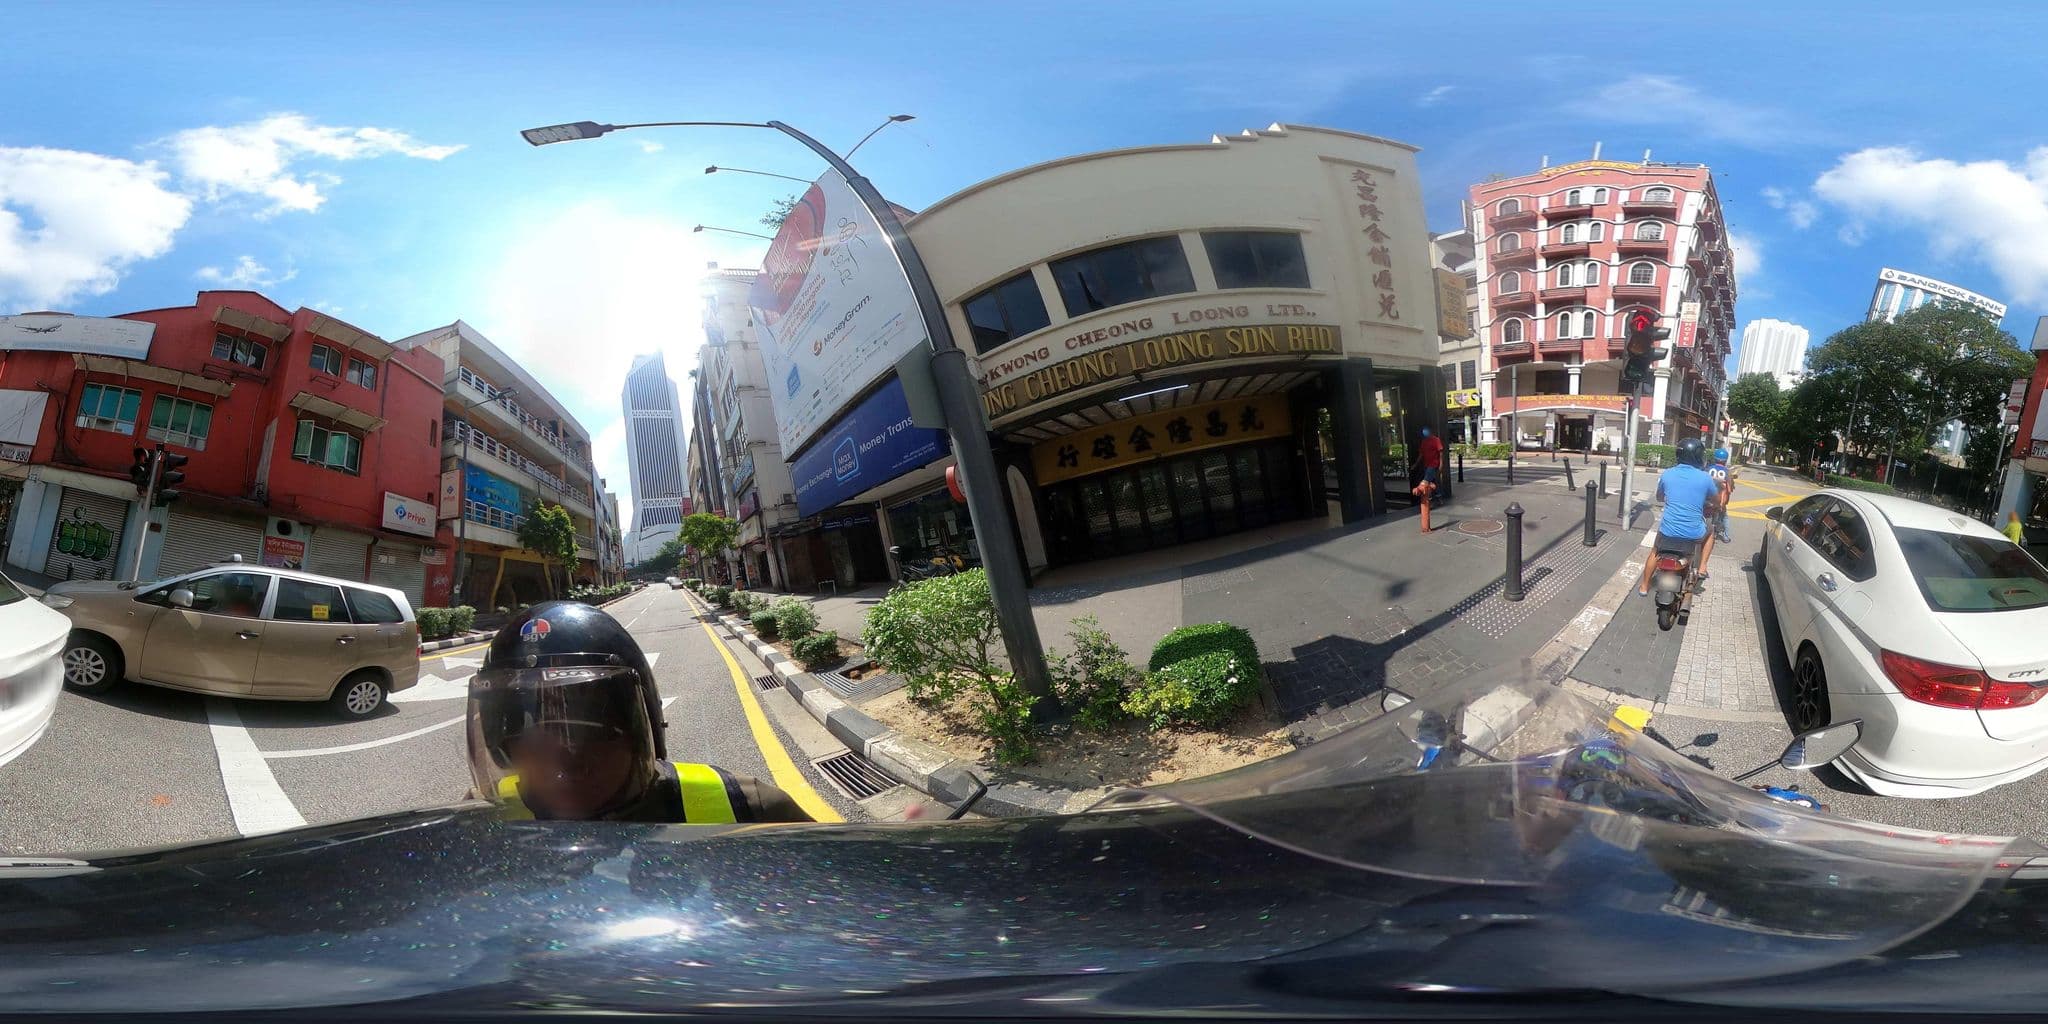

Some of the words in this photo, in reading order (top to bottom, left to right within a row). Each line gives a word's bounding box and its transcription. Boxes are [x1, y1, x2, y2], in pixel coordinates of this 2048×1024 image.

[1898, 275, 1966, 298] BANGKOK
[1968, 294, 2003, 313] BANK
[824, 295, 870, 346] MoneyGram
[988, 346, 1050, 381] KWONG
[1064, 317, 1153, 350] CHEONG
[1172, 305, 1249, 326] LOONG
[1024, 349, 1118, 401] CHEONG
[1127, 331, 1214, 371] LOONG
[859, 432, 886, 455] Money
[837, 460, 856, 475] Money
[838, 453, 851, 465] Max
[808, 467, 833, 487] Exchange
